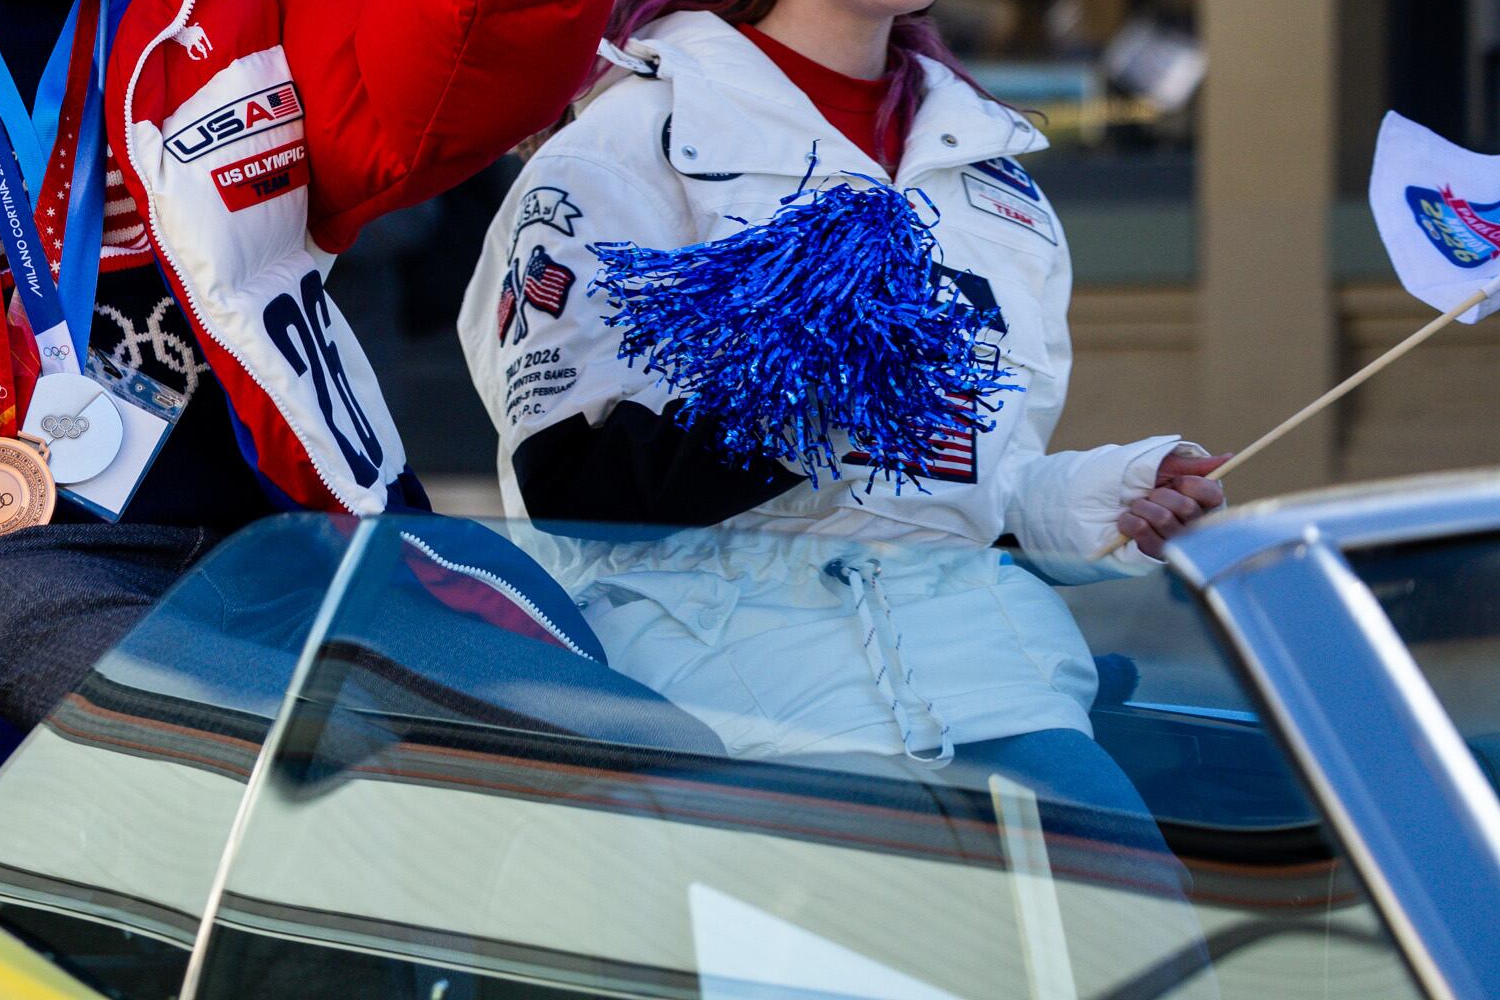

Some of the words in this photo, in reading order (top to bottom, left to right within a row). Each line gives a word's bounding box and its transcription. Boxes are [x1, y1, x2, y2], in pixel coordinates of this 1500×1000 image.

[172, 100, 276, 155] USA
[216, 169, 244, 187] US
[243, 146, 305, 178] OLYMPIC
[252, 172, 291, 198] TEAM
[1420, 199, 1480, 263] 2026
[1457, 207, 1495, 234] PARK
[17, 239, 43, 298] MILANO
[524, 347, 560, 369] 2026
[544, 367, 577, 380] GAMES
[263, 269, 384, 489] 26
